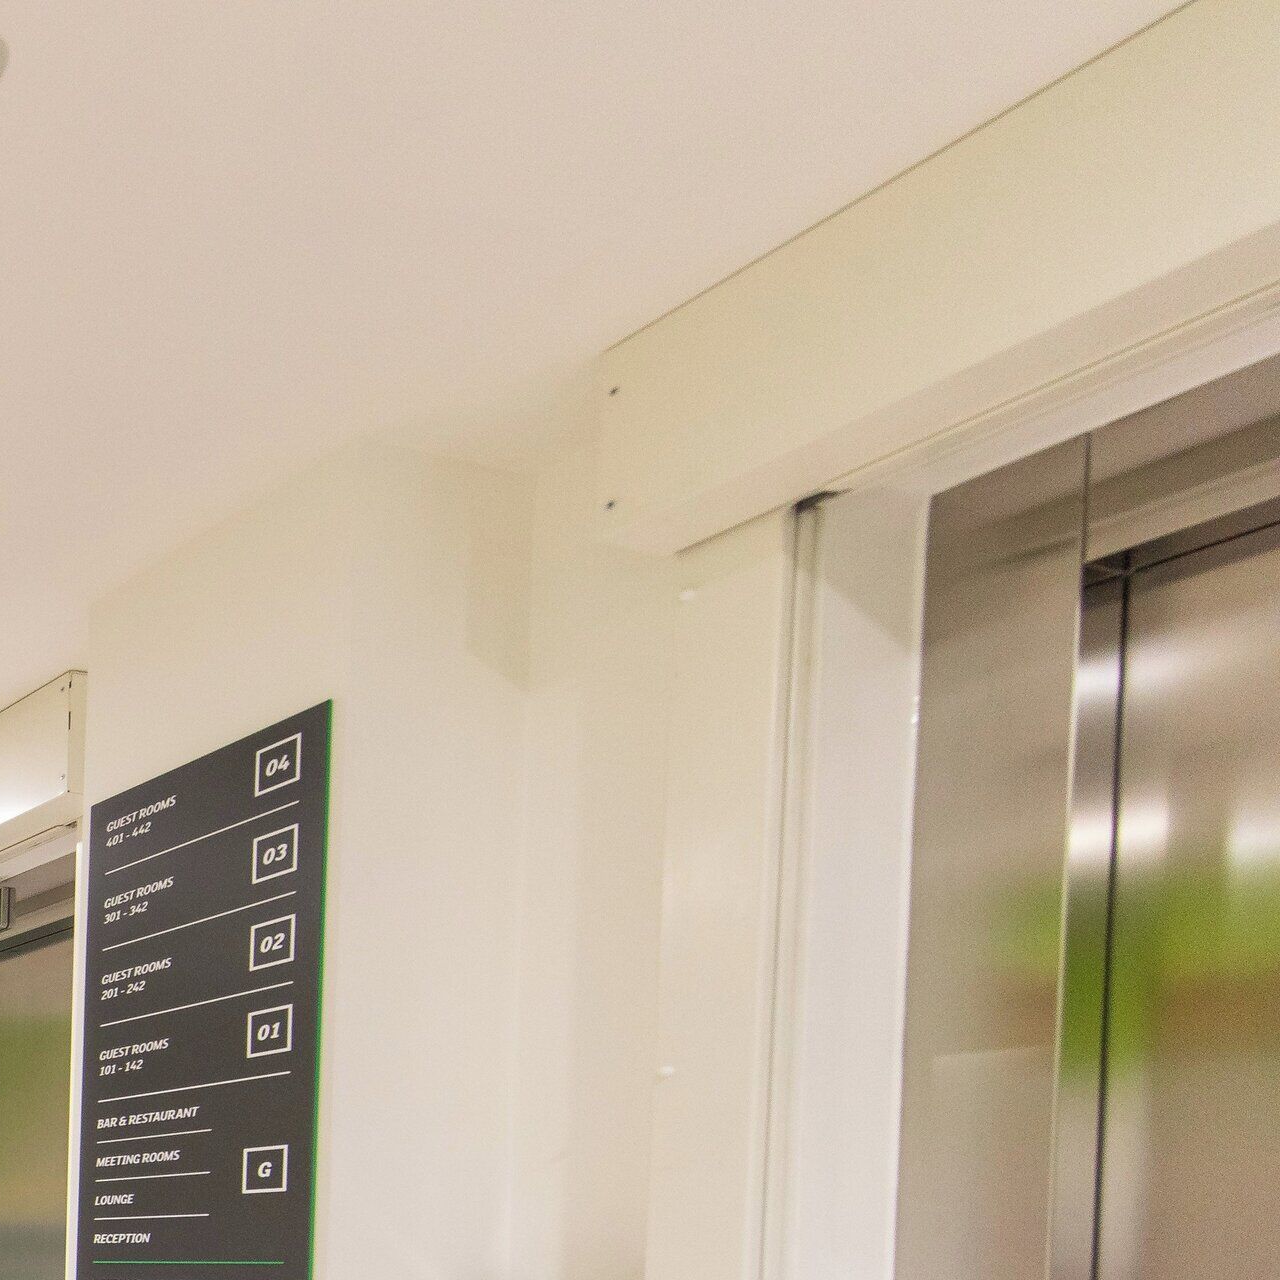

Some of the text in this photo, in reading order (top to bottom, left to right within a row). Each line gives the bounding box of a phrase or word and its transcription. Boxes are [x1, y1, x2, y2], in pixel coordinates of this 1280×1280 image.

[265, 754, 291, 778] 04
[105, 794, 177, 832] GUEST ROOMS
[105, 832, 125, 848] 401
[131, 821, 152, 837] 442
[262, 843, 288, 866] 03
[103, 875, 175, 910] GUEST ROOMS
[103, 909, 121, 925] 301
[128, 900, 149, 916] 342
[258, 932, 286, 954] 02
[101, 957, 173, 986] GUEST ROOMS
[100, 986, 119, 1001] 201
[126, 979, 146, 994] 242
[256, 1021, 281, 1042] 01
[99, 1037, 170, 1062] GUEST ROOMS
[98, 1064, 117, 1077] 101
[124, 1058, 144, 1073] 142
[96, 1105, 201, 1130] BAR & RESTAURANT
[95, 1149, 181, 1168] MEETING ROOMS
[257, 1161, 273, 1178] G
[94, 1193, 135, 1206] LOUNGE
[92, 1232, 152, 1244] RECEPTION
